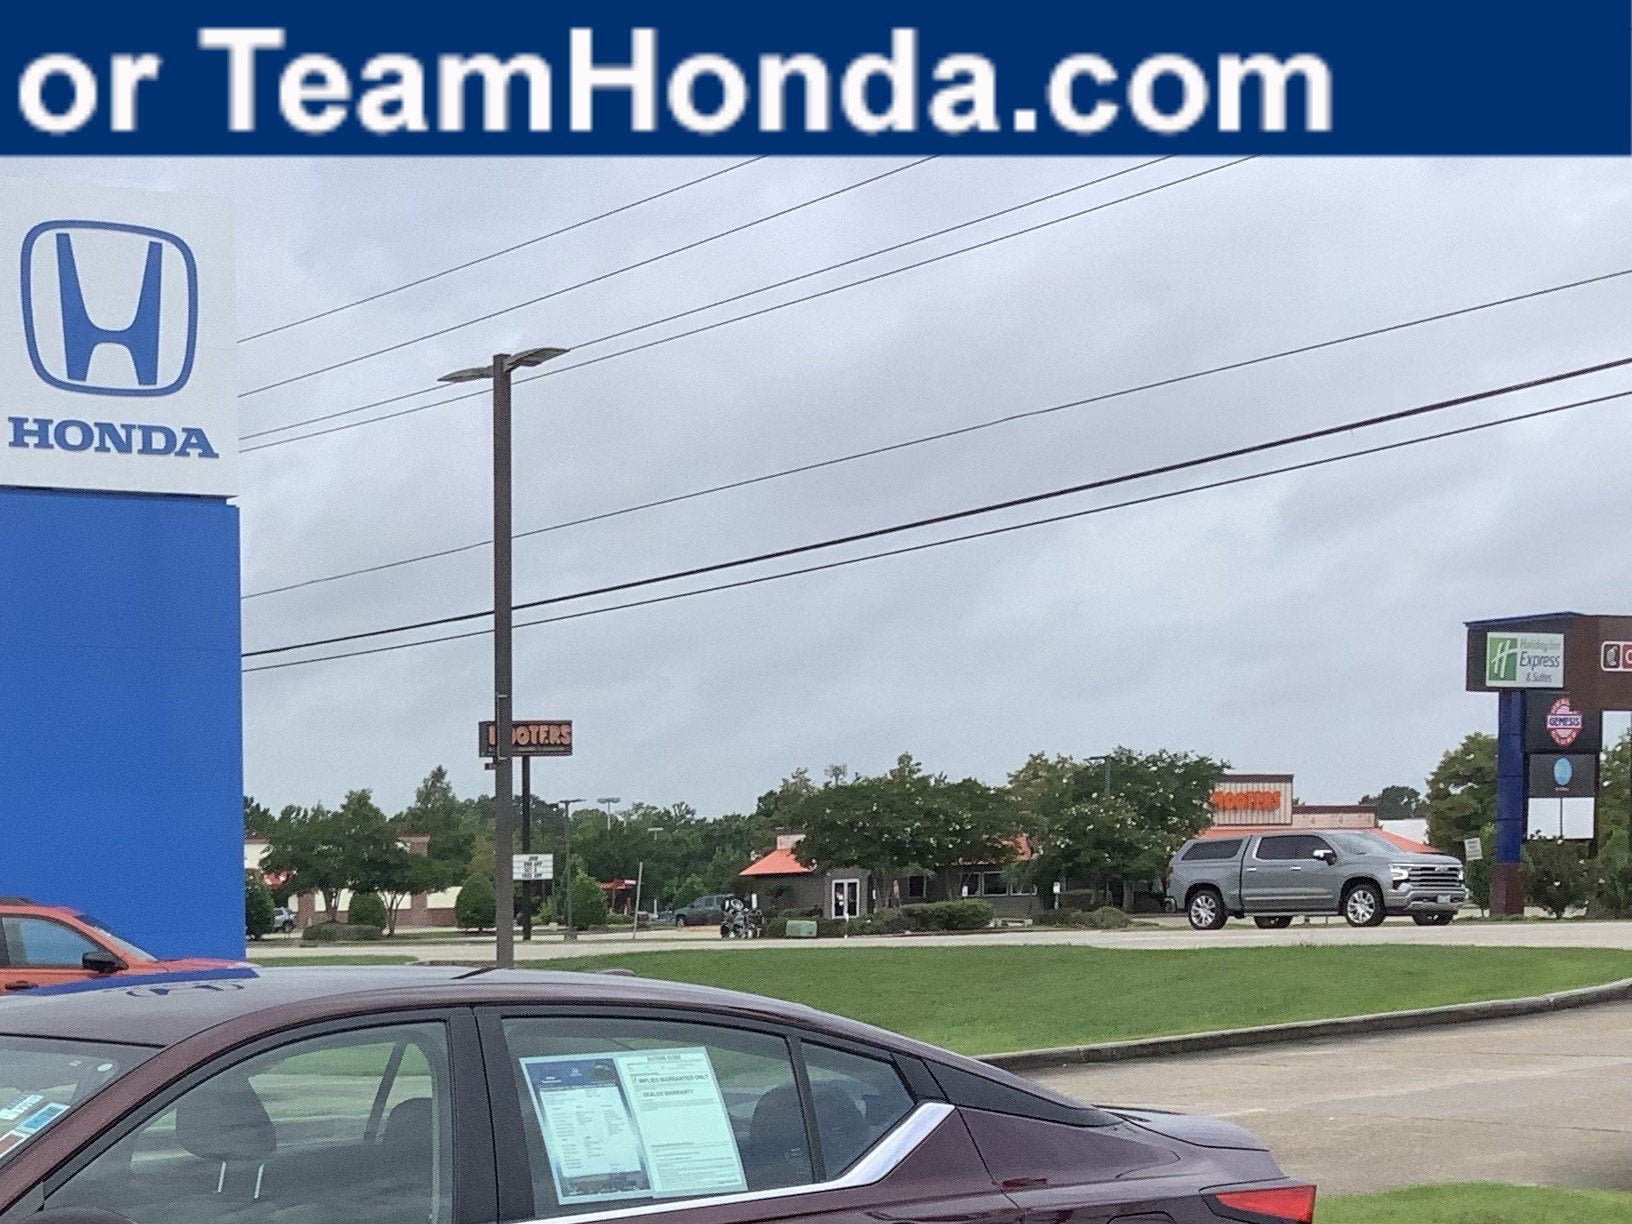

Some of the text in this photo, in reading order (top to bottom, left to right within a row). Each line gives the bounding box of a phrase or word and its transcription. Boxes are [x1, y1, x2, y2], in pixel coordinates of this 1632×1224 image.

[7, 415, 220, 459] HONDA
[1519, 651, 1561, 671] Express
[1532, 671, 1553, 683] Suites
[1548, 716, 1581, 727] GENESIS
